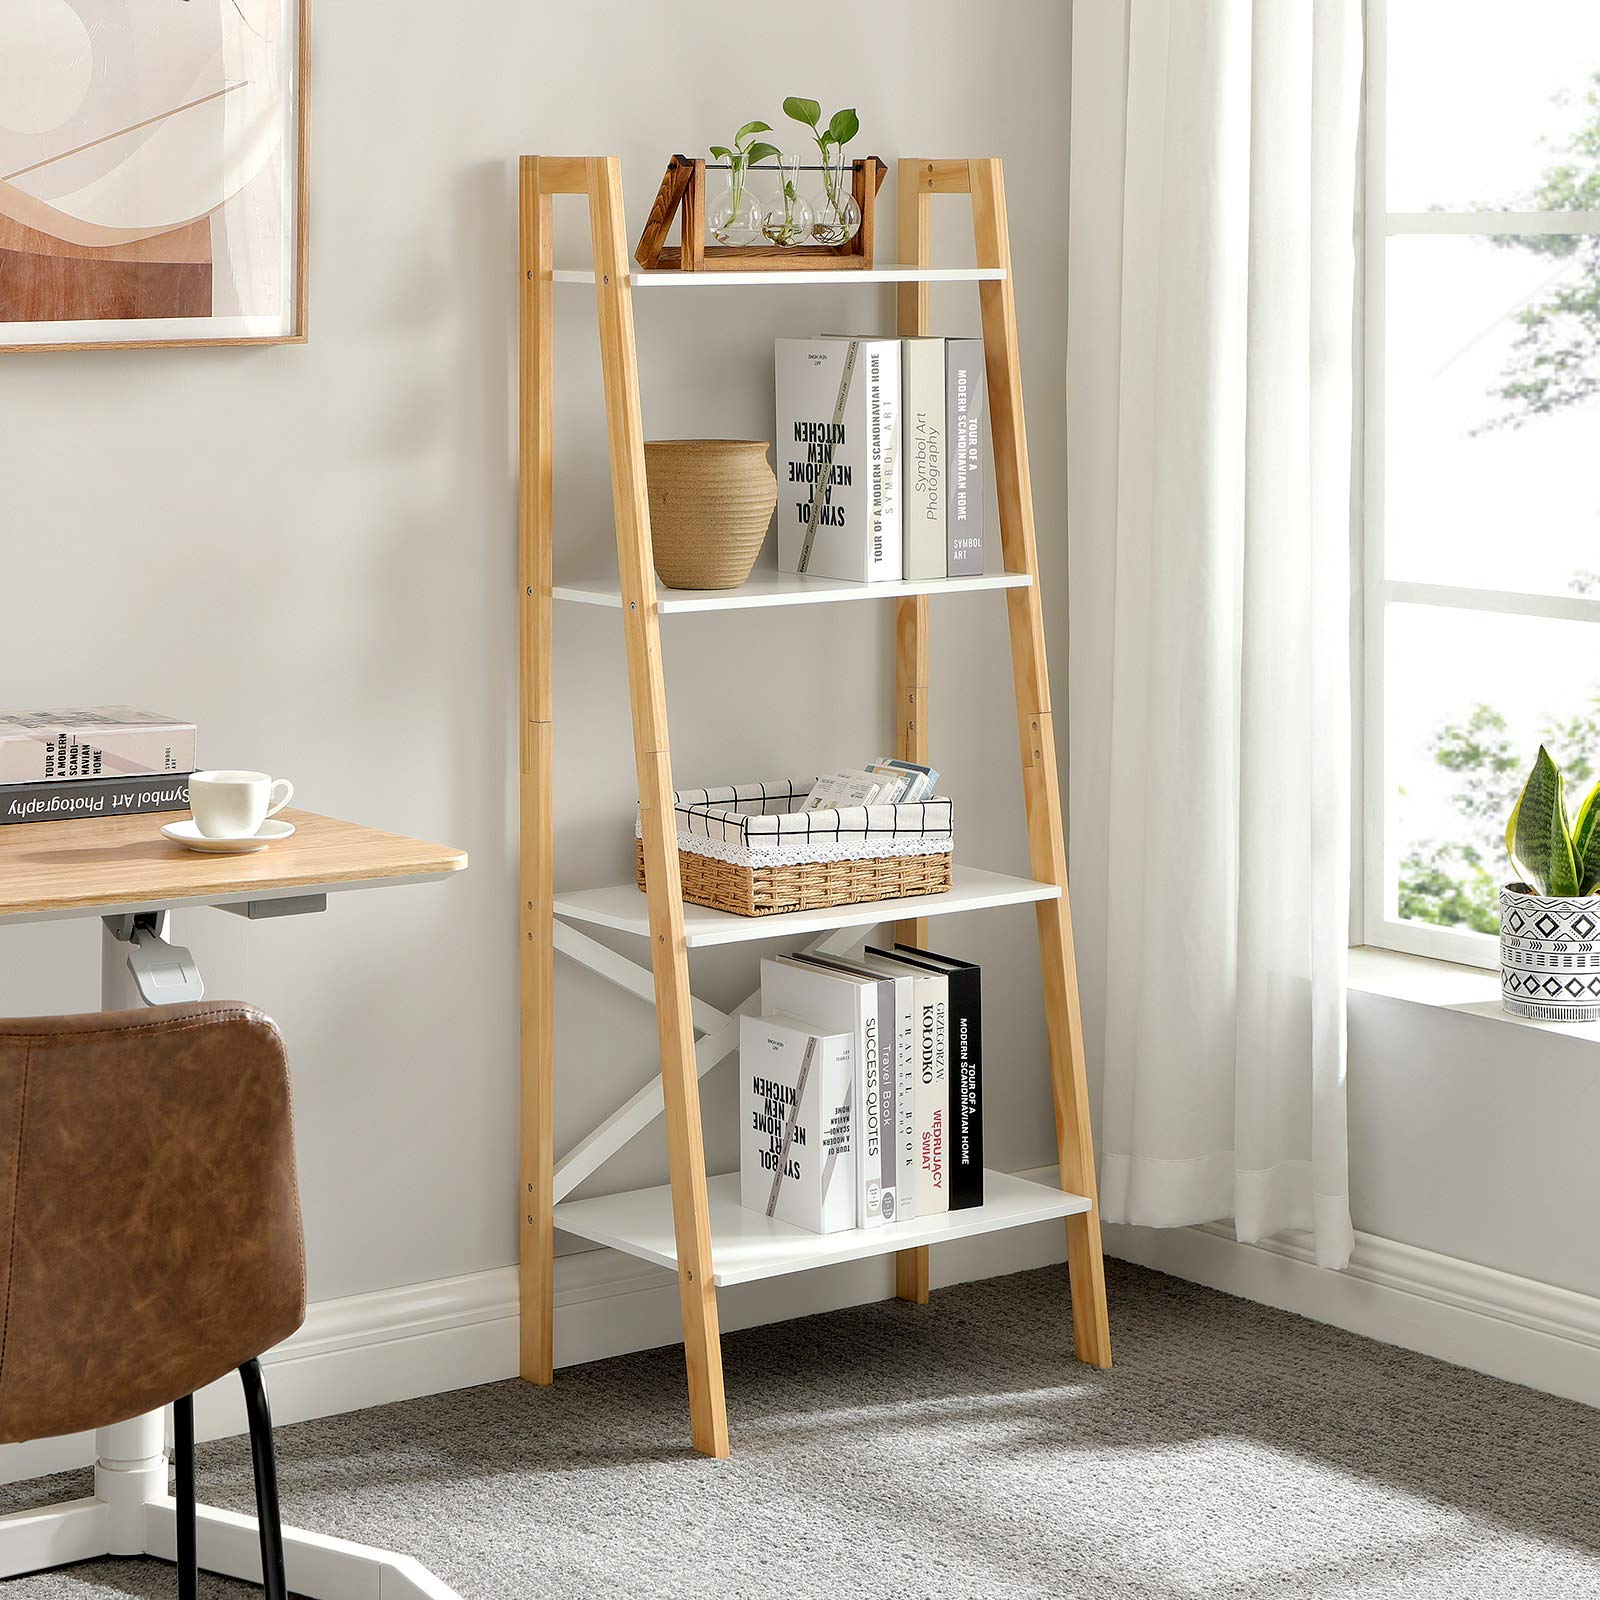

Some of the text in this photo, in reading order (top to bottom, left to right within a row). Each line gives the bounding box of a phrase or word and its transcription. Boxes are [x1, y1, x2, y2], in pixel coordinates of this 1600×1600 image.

[871, 353, 880, 383] HOME
[838, 392, 846, 412] HOME
[794, 422, 845, 445] KITCHEN
[872, 386, 881, 461] SCANDINAVIAN
[969, 418, 978, 446] TOUR
[808, 443, 832, 464] NEW
[883, 401, 894, 514] SYMBOL ART
[915, 413, 928, 493] Symbol Art
[958, 369, 967, 521] MODERN SCANDINAVIAN HOME
[969, 448, 978, 461] OF
[789, 462, 823, 484] HOME
[873, 464, 882, 507] MODERN
[927, 427, 941, 521] Photography
[808, 484, 832, 505] AT
[796, 503, 845, 527] SYMOL
[874, 520, 883, 533] OF
[874, 536, 883, 563] TOUR
[953, 538, 982, 549] SYMBOL
[953, 550, 967, 561] ART
[45, 742, 55, 778] TOUR OF
[58, 733, 67, 770] MODERN
[82, 745, 91, 775] NAVIAN
[93, 750, 102, 775] HOME
[7, 785, 190, 818] Symbol Art Photography
[922, 1005, 934, 1085] KOŁODKO
[936, 1002, 945, 1067] GRZEGORZ
[866, 1018, 879, 1157] SUCCESS QUOTES
[883, 1044, 892, 1127] Travel Book
[905, 1014, 913, 1167] TRAVEL BOOK
[968, 1064, 976, 1090] TOUR
[753, 1076, 797, 1107] KITCHEN
[960, 1018, 970, 1165] MODERN SCANDINAVIAN HOME
[969, 1092, 977, 1105] OF
[765, 1098, 785, 1121] NEW
[831, 1116, 850, 1125] NAVIAN
[835, 1106, 850, 1115] HOME
[753, 1111, 782, 1138] HOME
[769, 1136, 783, 1156] RT
[823, 1136, 845, 1147] MODERN
[828, 1145, 850, 1156] TOUR OF
[922, 1131, 933, 1171] ŚWIAT
[932, 1109, 942, 1189] WĘDRUJĄCY
